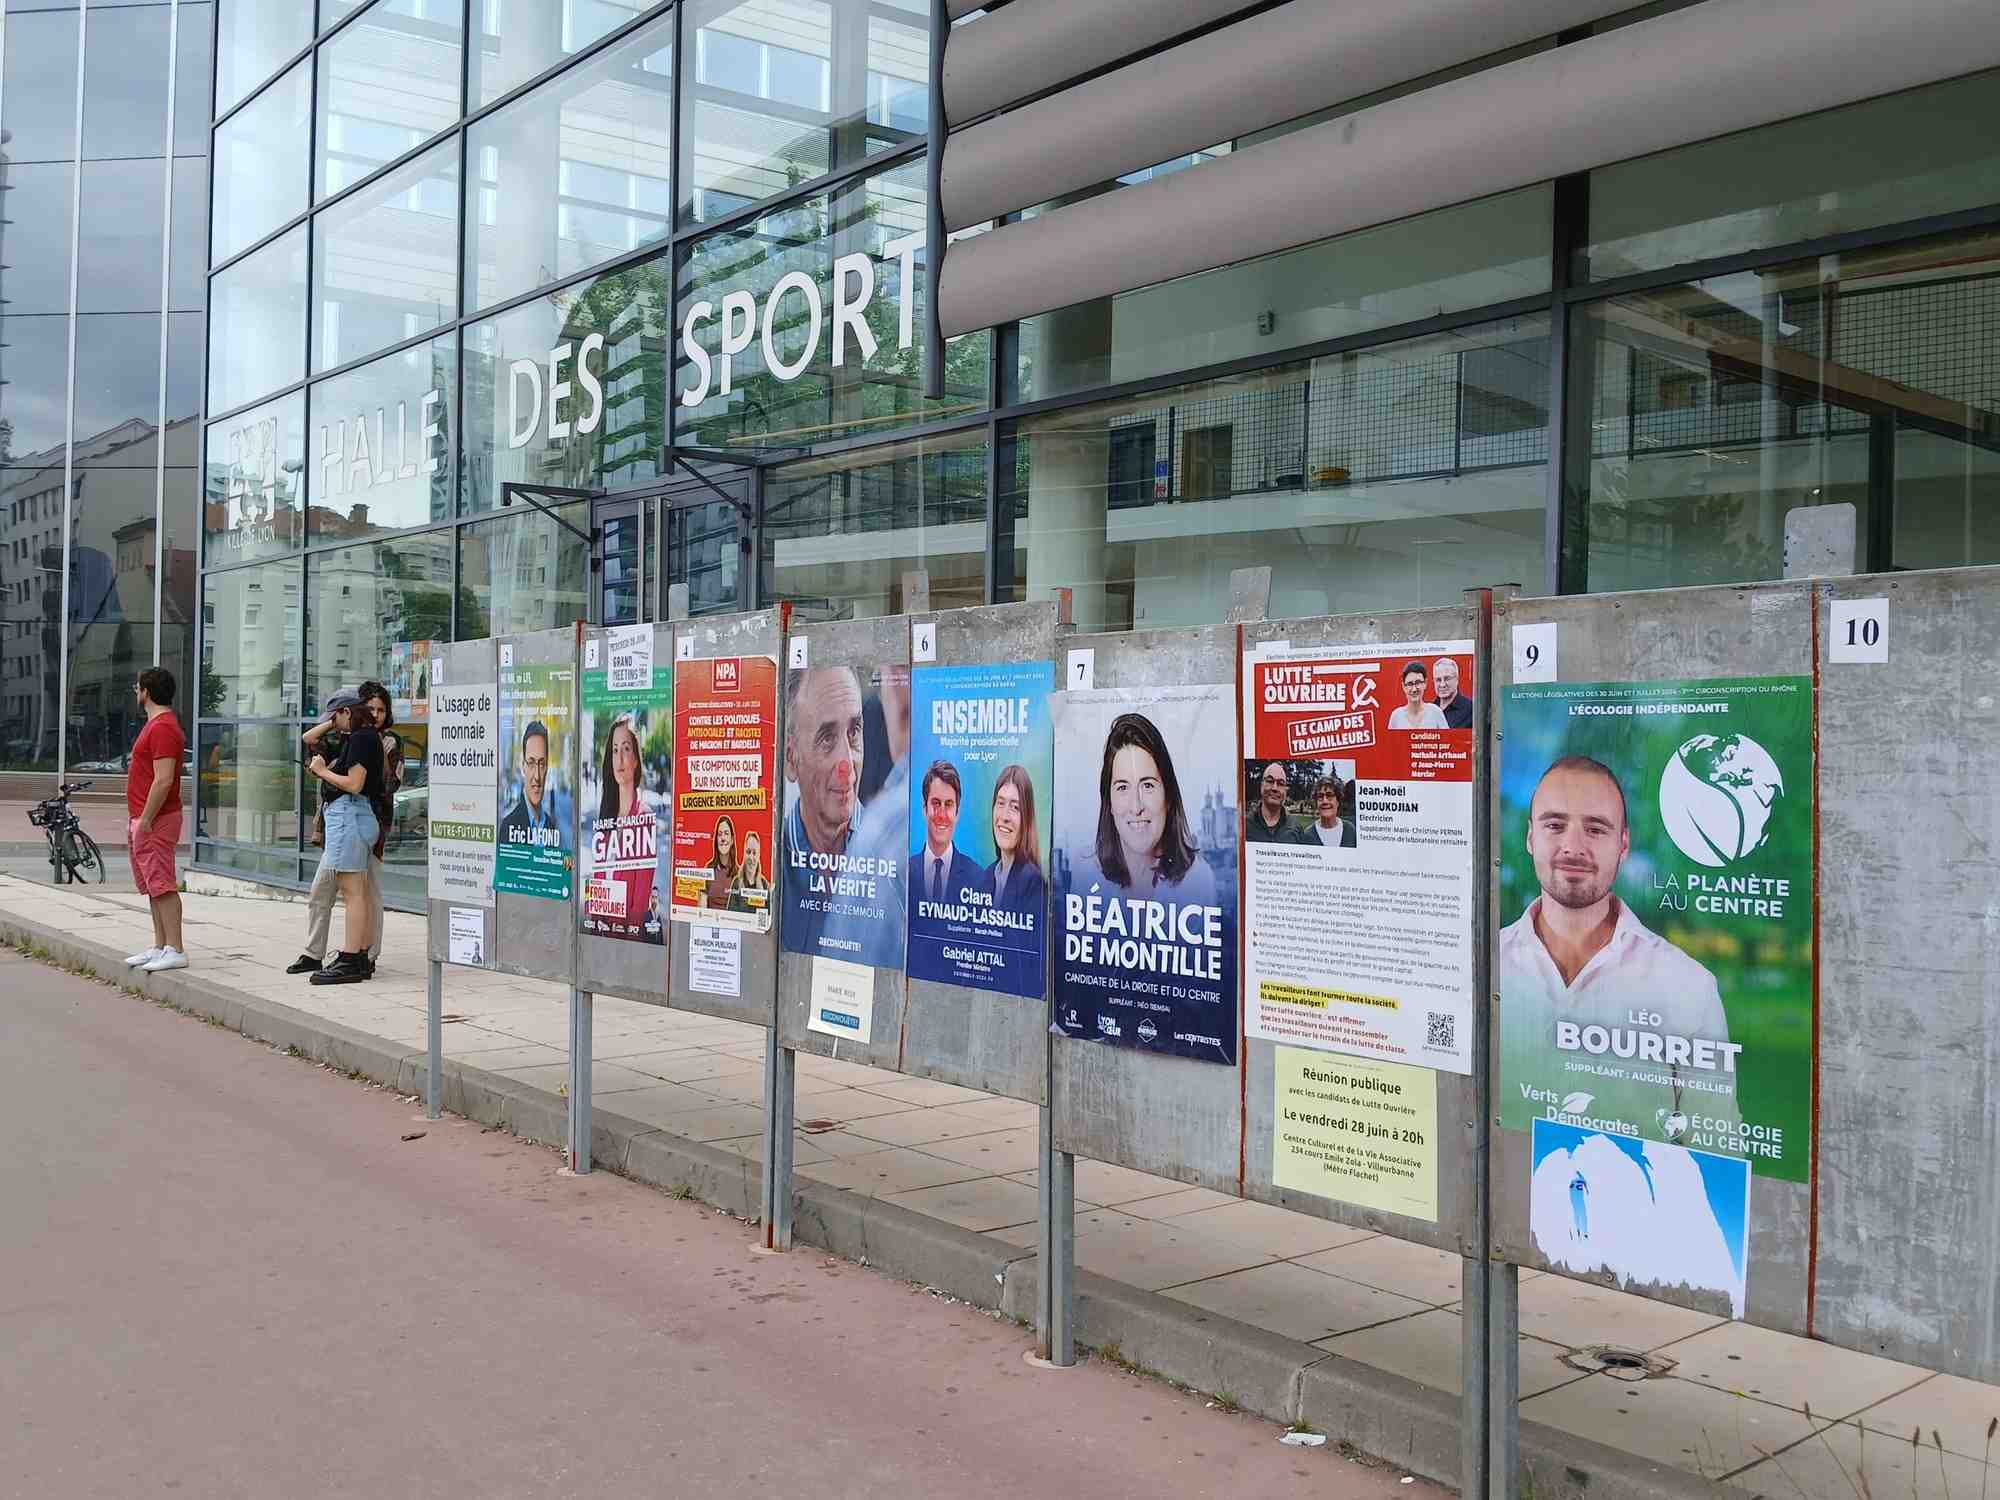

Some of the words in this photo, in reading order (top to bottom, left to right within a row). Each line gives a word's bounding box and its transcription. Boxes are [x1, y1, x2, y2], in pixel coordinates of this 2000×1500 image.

[509, 333, 604, 449] DES
[320, 389, 439, 499] HALLE
[921, 634, 929, 652] 6
[1845, 618, 1880, 646] 10
[590, 649, 594, 661] 3
[613, 655, 632, 667] GRAND
[796, 649, 802, 664] 5
[1526, 644, 1539, 667] 9
[716, 662, 736, 680] NPA
[1077, 663, 1086, 681] 7
[1264, 666, 1312, 685] LUTTE
[1264, 680, 1346, 703] OUVRIÈRE
[1695, 685, 1757, 695] CIRCONSCRIPTION
[436, 694, 475, 717] L'usage
[478, 693, 491, 711] de
[932, 698, 1029, 734] ENSEMBLE
[1568, 704, 1633, 715] L'ÉCOLOGIE
[1635, 702, 1728, 714] INDÉPENDANTE
[441, 721, 485, 739] monnaie
[1295, 721, 1308, 736] LE
[1309, 717, 1341, 734] CAMP
[1343, 714, 1364, 730] DES
[1292, 730, 1371, 752] TRAVAILLEURS
[433, 751, 458, 767] nous
[460, 749, 495, 768] détruit
[690, 760, 700, 772] NE
[702, 760, 740, 773] COMPTONS
[742, 760, 760, 772] QUE
[963, 753, 981, 762] pour
[981, 751, 998, 763] Lyon
[694, 776, 708, 788] SUR
[710, 776, 725, 788] NOS
[726, 776, 751, 788] LUTTES
[1359, 785, 1406, 797] Jean-Noël
[682, 796, 714, 809] URGENCE
[1359, 801, 1418, 812] DUDUKDJIAN
[592, 813, 657, 831] MARIE-CHARLOTTE
[508, 825, 525, 844] Eric
[527, 827, 560, 848] LAFOND
[592, 825, 657, 863] GARIN
[791, 851, 807, 868] LE
[809, 852, 875, 875] COURAGE
[878, 859, 897, 878] DE
[590, 886, 610, 900] FRONT
[809, 875, 826, 893] LA
[829, 875, 876, 899] VÉRITÉ
[1653, 872, 1680, 889] LA
[1687, 873, 1790, 897] PLANÈTE
[960, 887, 993, 906] Clara
[1659, 893, 1688, 911] AU
[1695, 896, 1783, 918] CENTRE
[590, 900, 625, 916] POPULAIRE
[799, 899, 820, 912] AVEC
[822, 898, 841, 914] ÉRIC
[843, 904, 885, 921] ZEMMOUR
[919, 901, 1034, 931] EYNAUD-LASSALLE
[1065, 882, 1222, 947] BÉATRICE
[942, 946, 975, 962] Gabriel
[977, 952, 1005, 967] ATTAL
[1065, 934, 1093, 963] DE
[1099, 937, 1222, 980] MONTILLE
[1064, 972, 1107, 988] CANDIDATE
[1108, 977, 1119, 989] DE
[1120, 978, 1131, 990] LA
[1131, 980, 1159, 994] DROITE
[1160, 984, 1171, 996] ET
[1172, 986, 1187, 998] DU
[1188, 988, 1222, 1003] CENTRE
[1270, 983, 1306, 995] travailleurs
[1628, 1008, 1662, 1026] LÉO
[1556, 1020, 1742, 1073] BOURRET
[1303, 1067, 1348, 1086] Réunion
[1350, 1076, 1401, 1096] publique
[1564, 1061, 1625, 1079] SUPPLÉANT
[1631, 1072, 1686, 1089] AUGUSTIN
[1688, 1078, 1733, 1095] CELLIER
[1289, 1087, 1304, 1096] avec
[1305, 1088, 1315, 1098] les
[1317, 1091, 1350, 1104] candidats
[1351, 1096, 1361, 1106] de
[1362, 1099, 1381, 1110] Lutte
[1383, 1102, 1416, 1116] Ouvrière
[1520, 1082, 1558, 1104] Verts
[1284, 1107, 1297, 1121] Le
[1299, 1111, 1348, 1131] vendredi
[1351, 1120, 1365, 1134] 28
[1366, 1121, 1389, 1139] juin
[1392, 1127, 1399, 1140] à
[1402, 1129, 1424, 1146] 20h
[1691, 1112, 1783, 1143] ÉCOLOGIE
[1283, 1133, 1307, 1145] Centre
[1307, 1137, 1336, 1151] Culturel
[1337, 1142, 1345, 1153] et
[1346, 1143, 1355, 1155] de
[1356, 1145, 1364, 1157] la
[1364, 1147, 1378, 1160] Vie
[1378, 1151, 1422, 1169] Associative
[1690, 1134, 1714, 1147] AU
[1717, 1136, 1782, 1159] CENTRE
[1304, 1148, 1323, 1160] cours
[1345, 1156, 1362, 1168] Zola
[1367, 1160, 1415, 1179] Villeurbanne
